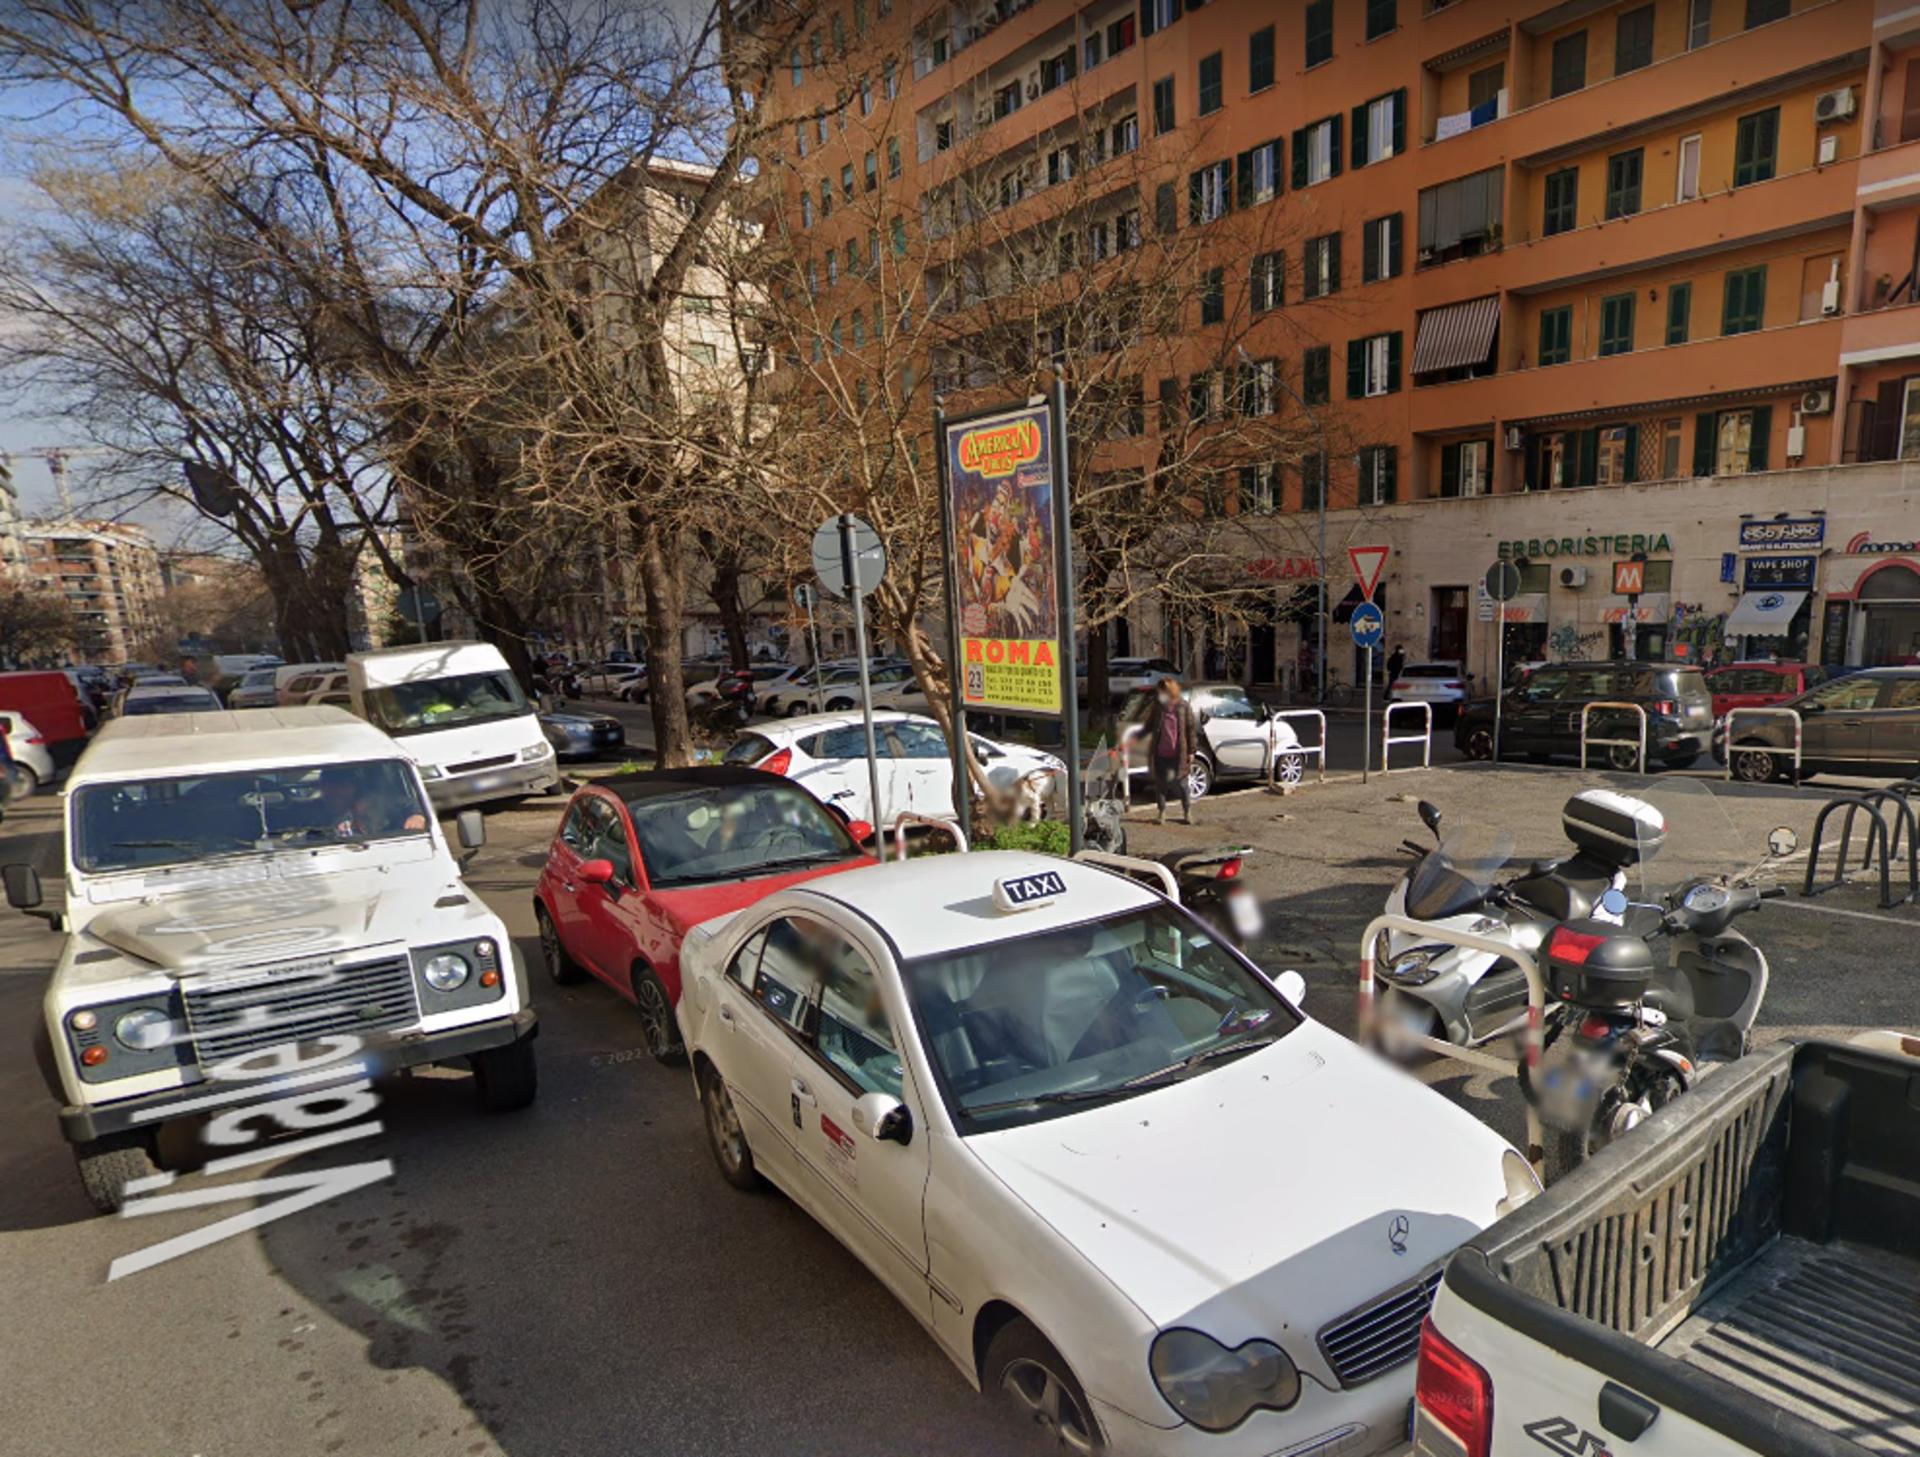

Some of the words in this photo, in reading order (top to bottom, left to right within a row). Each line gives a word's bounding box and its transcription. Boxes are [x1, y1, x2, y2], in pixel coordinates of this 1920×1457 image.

[1497, 533, 1671, 559] ERBORISTERIA
[1616, 567, 1642, 588] M
[1752, 560, 1777, 569] VAPE
[1781, 560, 1810, 569] SHOP
[965, 640, 1054, 666] ROMA
[1006, 874, 1062, 900] TAXI
